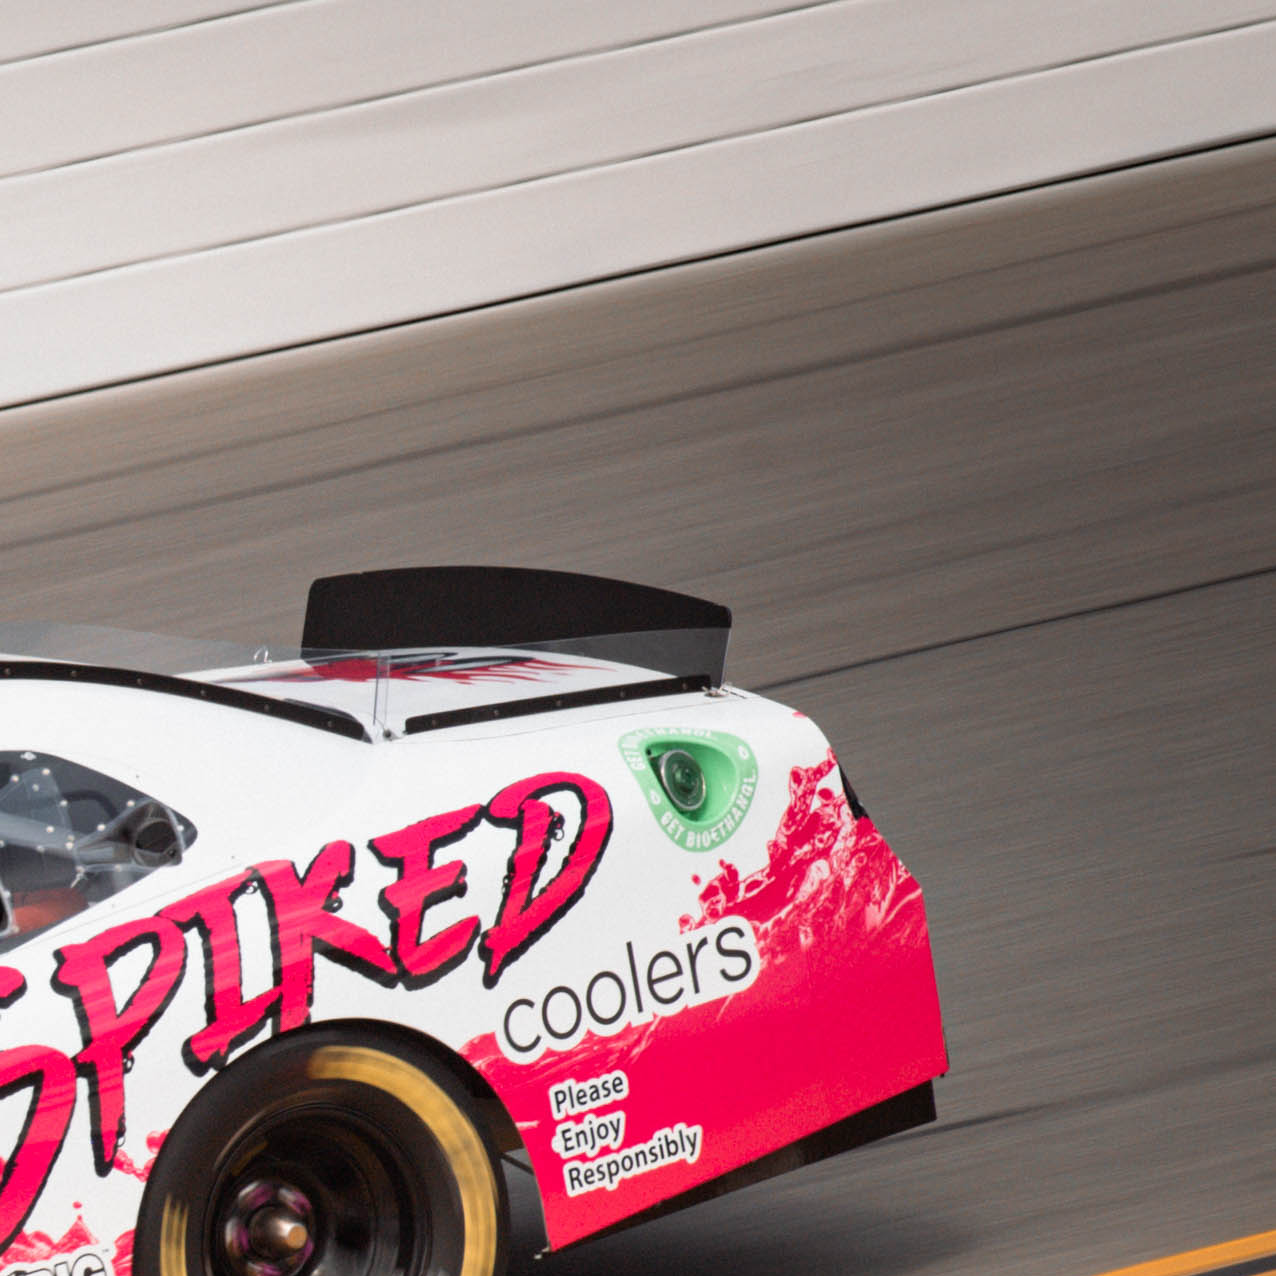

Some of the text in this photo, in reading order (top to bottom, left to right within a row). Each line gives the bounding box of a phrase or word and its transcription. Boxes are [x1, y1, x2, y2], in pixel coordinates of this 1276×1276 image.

[660, 768, 757, 849] GET BIOETHANOL
[503, 926, 753, 1053] coolers
[554, 1075, 625, 1113] Please
[561, 1116, 622, 1153] Enjoy
[567, 1128, 698, 1191] Responsibly
